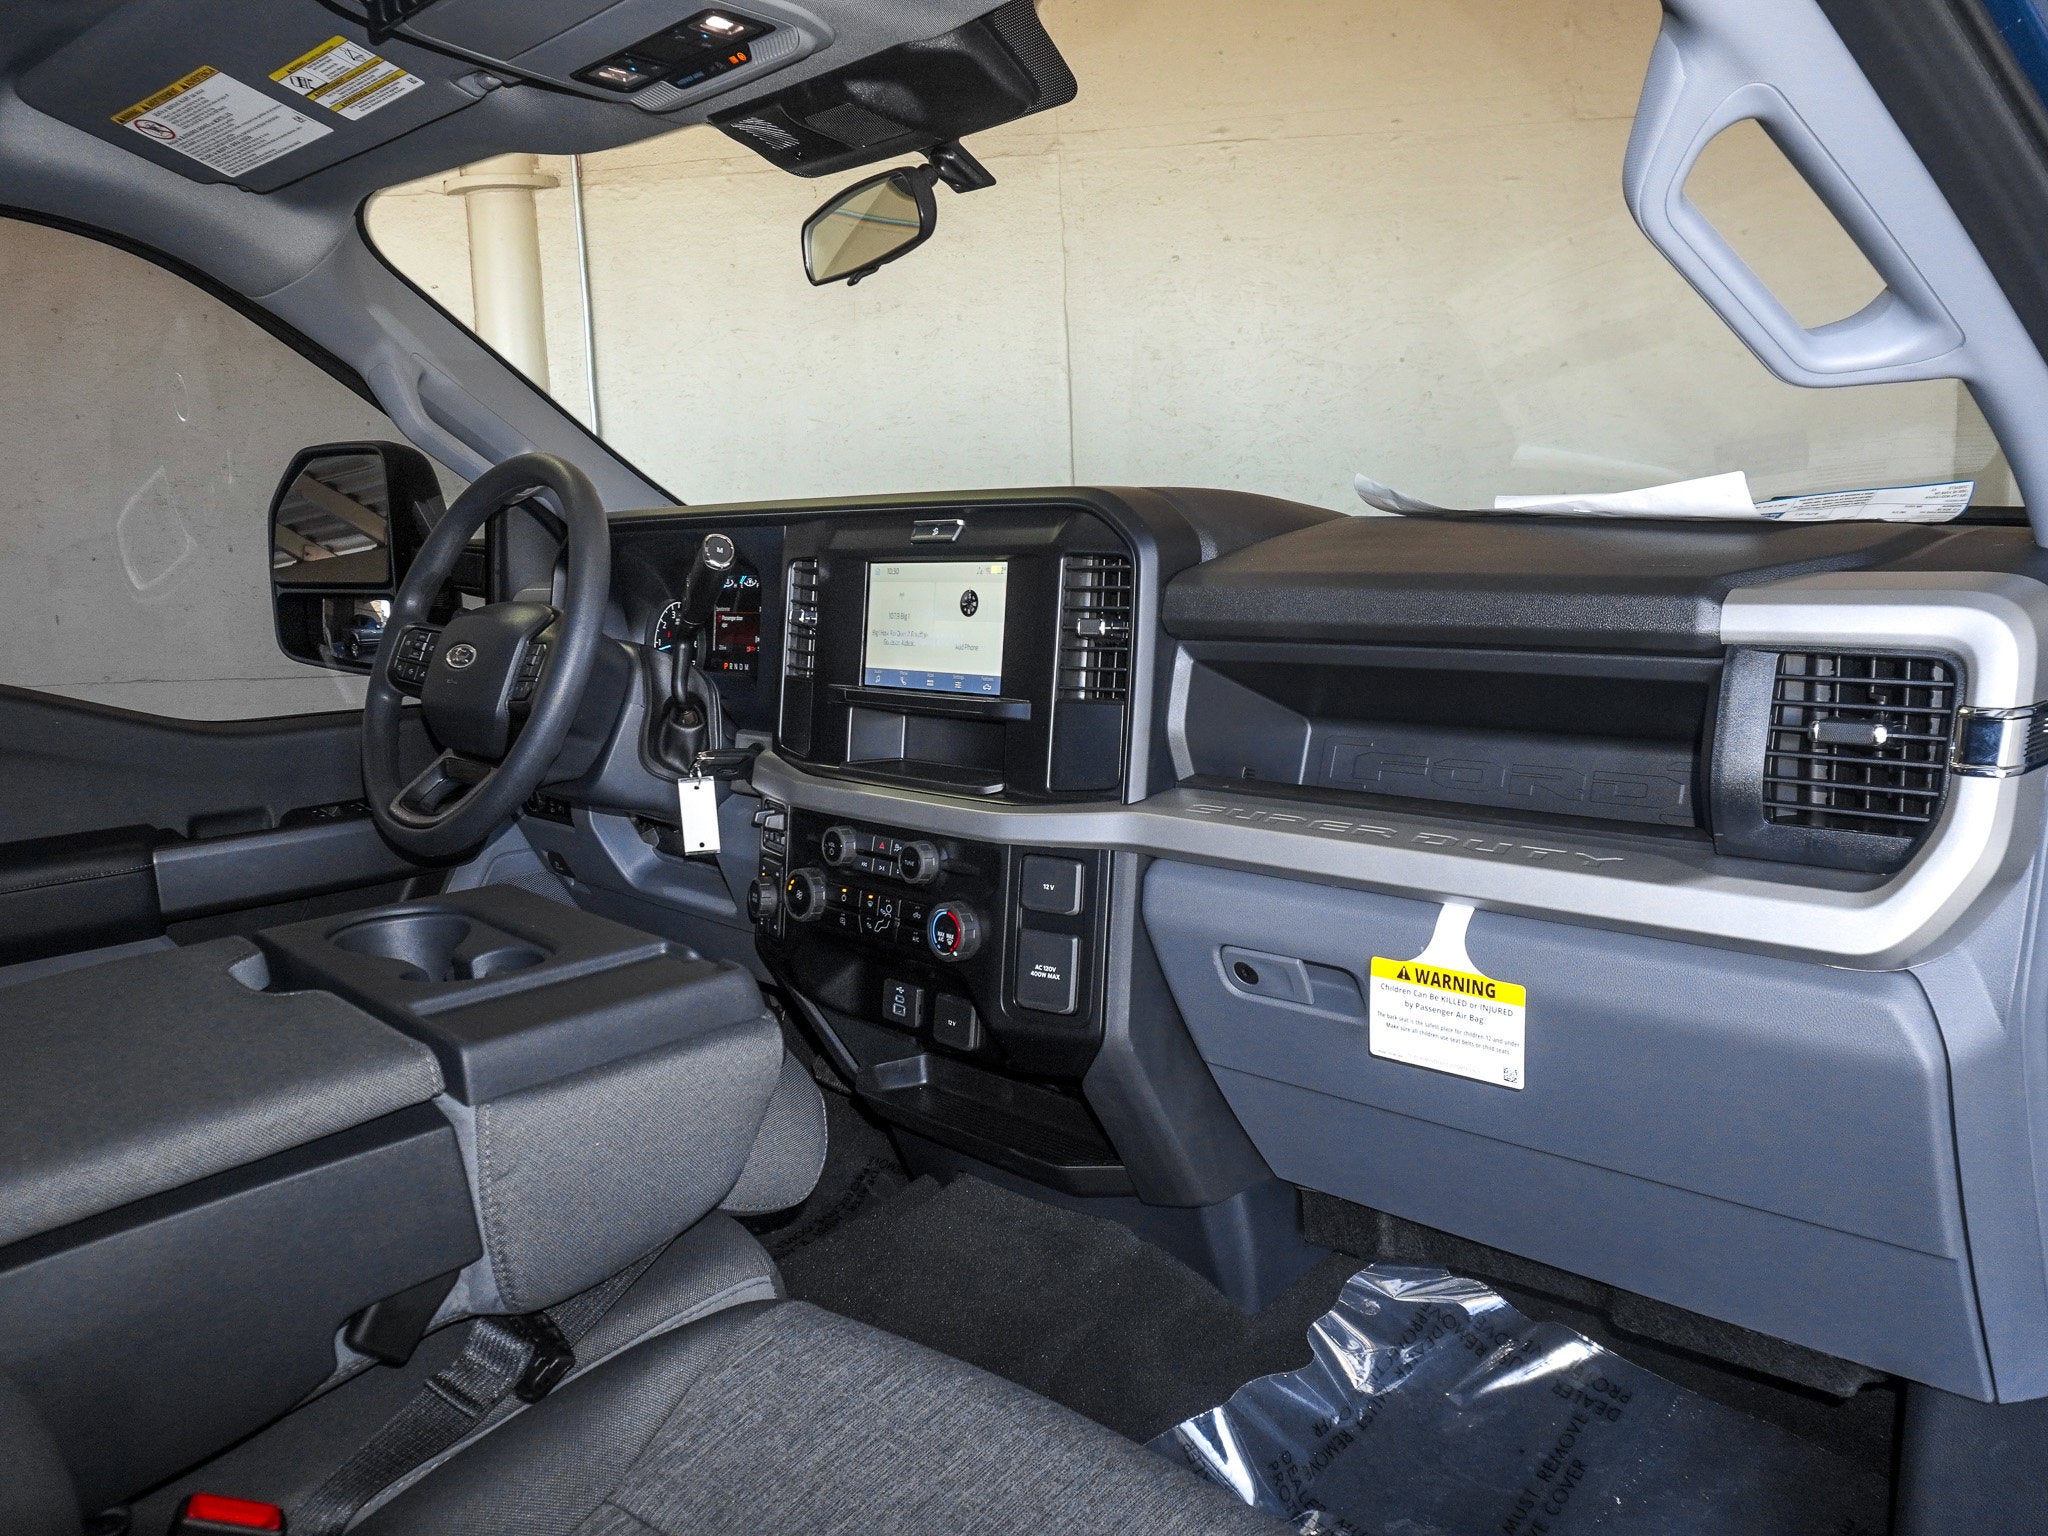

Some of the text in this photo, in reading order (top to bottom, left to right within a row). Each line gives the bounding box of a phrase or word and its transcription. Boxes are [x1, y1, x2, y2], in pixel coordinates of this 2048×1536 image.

[716, 546, 724, 554] M
[671, 610, 676, 619] 3
[662, 621, 667, 630] 2
[723, 662, 729, 670] P
[1184, 803, 1624, 867] SUPER DUTY
[1030, 970, 1060, 981] 400W MAX
[1034, 963, 1057, 973] AC 120V
[1415, 967, 1496, 999] WARNING
[1380, 982, 1514, 1018] Children Can Be KILLED or INJURED
[1404, 1000, 1414, 1010] by
[1415, 1002, 1454, 1018] Passenger
[1456, 1011, 1467, 1020] Air
[1536, 1410, 1590, 1483] REMOVE
[1545, 1458, 1588, 1516] COVER
